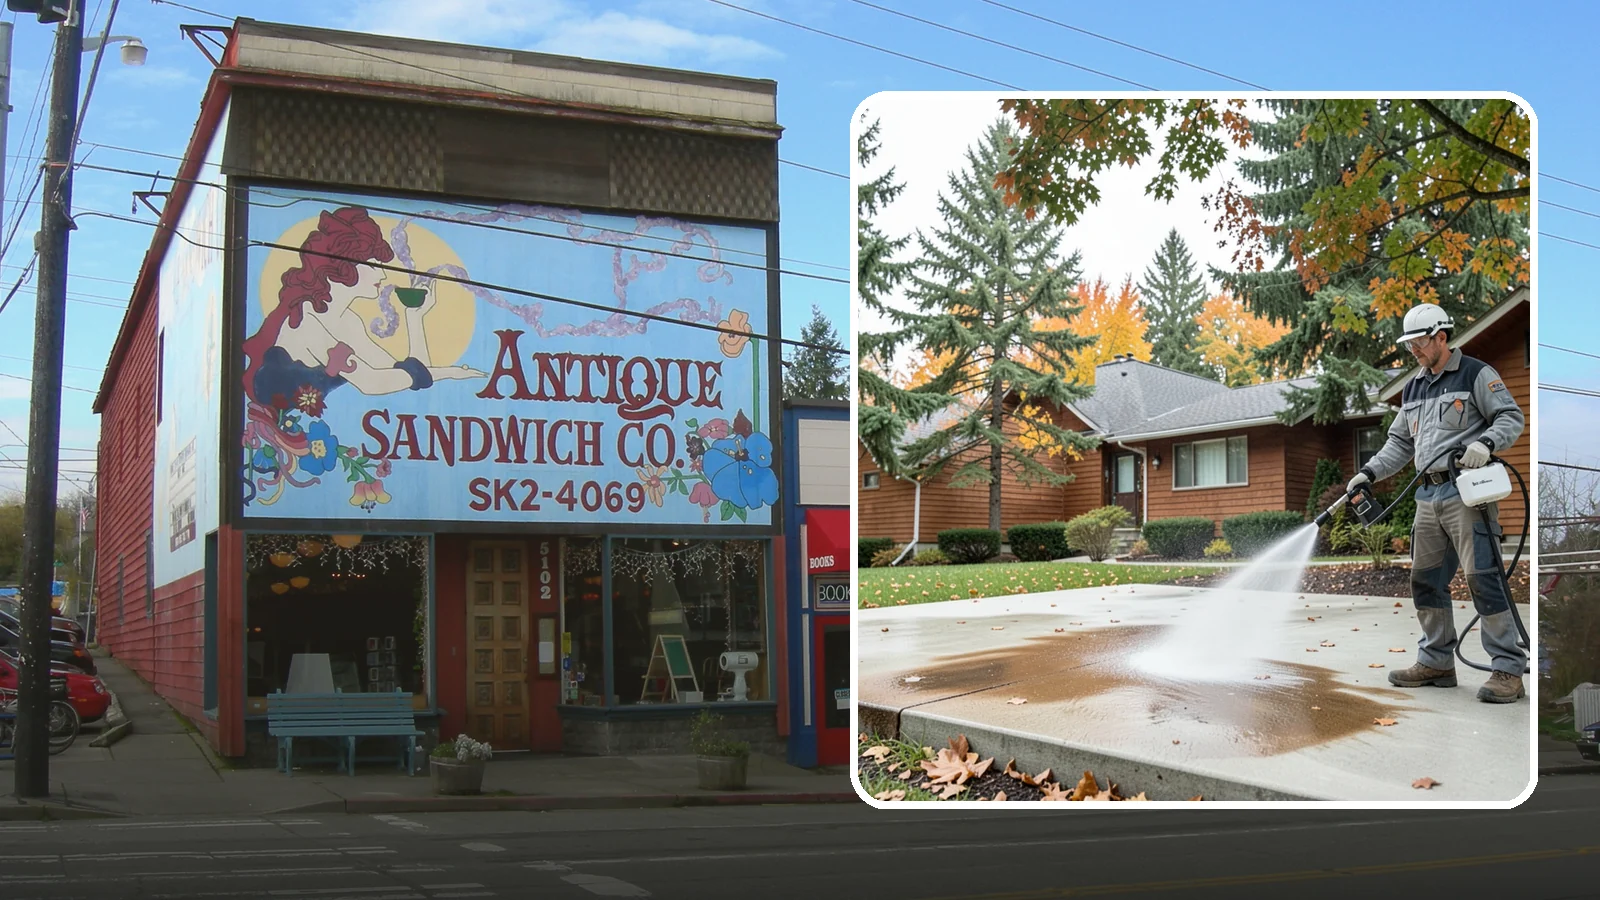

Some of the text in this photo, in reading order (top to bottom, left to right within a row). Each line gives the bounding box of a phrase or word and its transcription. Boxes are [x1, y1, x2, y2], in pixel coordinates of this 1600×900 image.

[476, 330, 723, 421] ANTIQUE
[361, 408, 684, 469] SANDWICH CO.
[468, 477, 646, 514] SK2-4069
[540, 542, 551, 599] 5102
[809, 555, 834, 569] BOOKS
